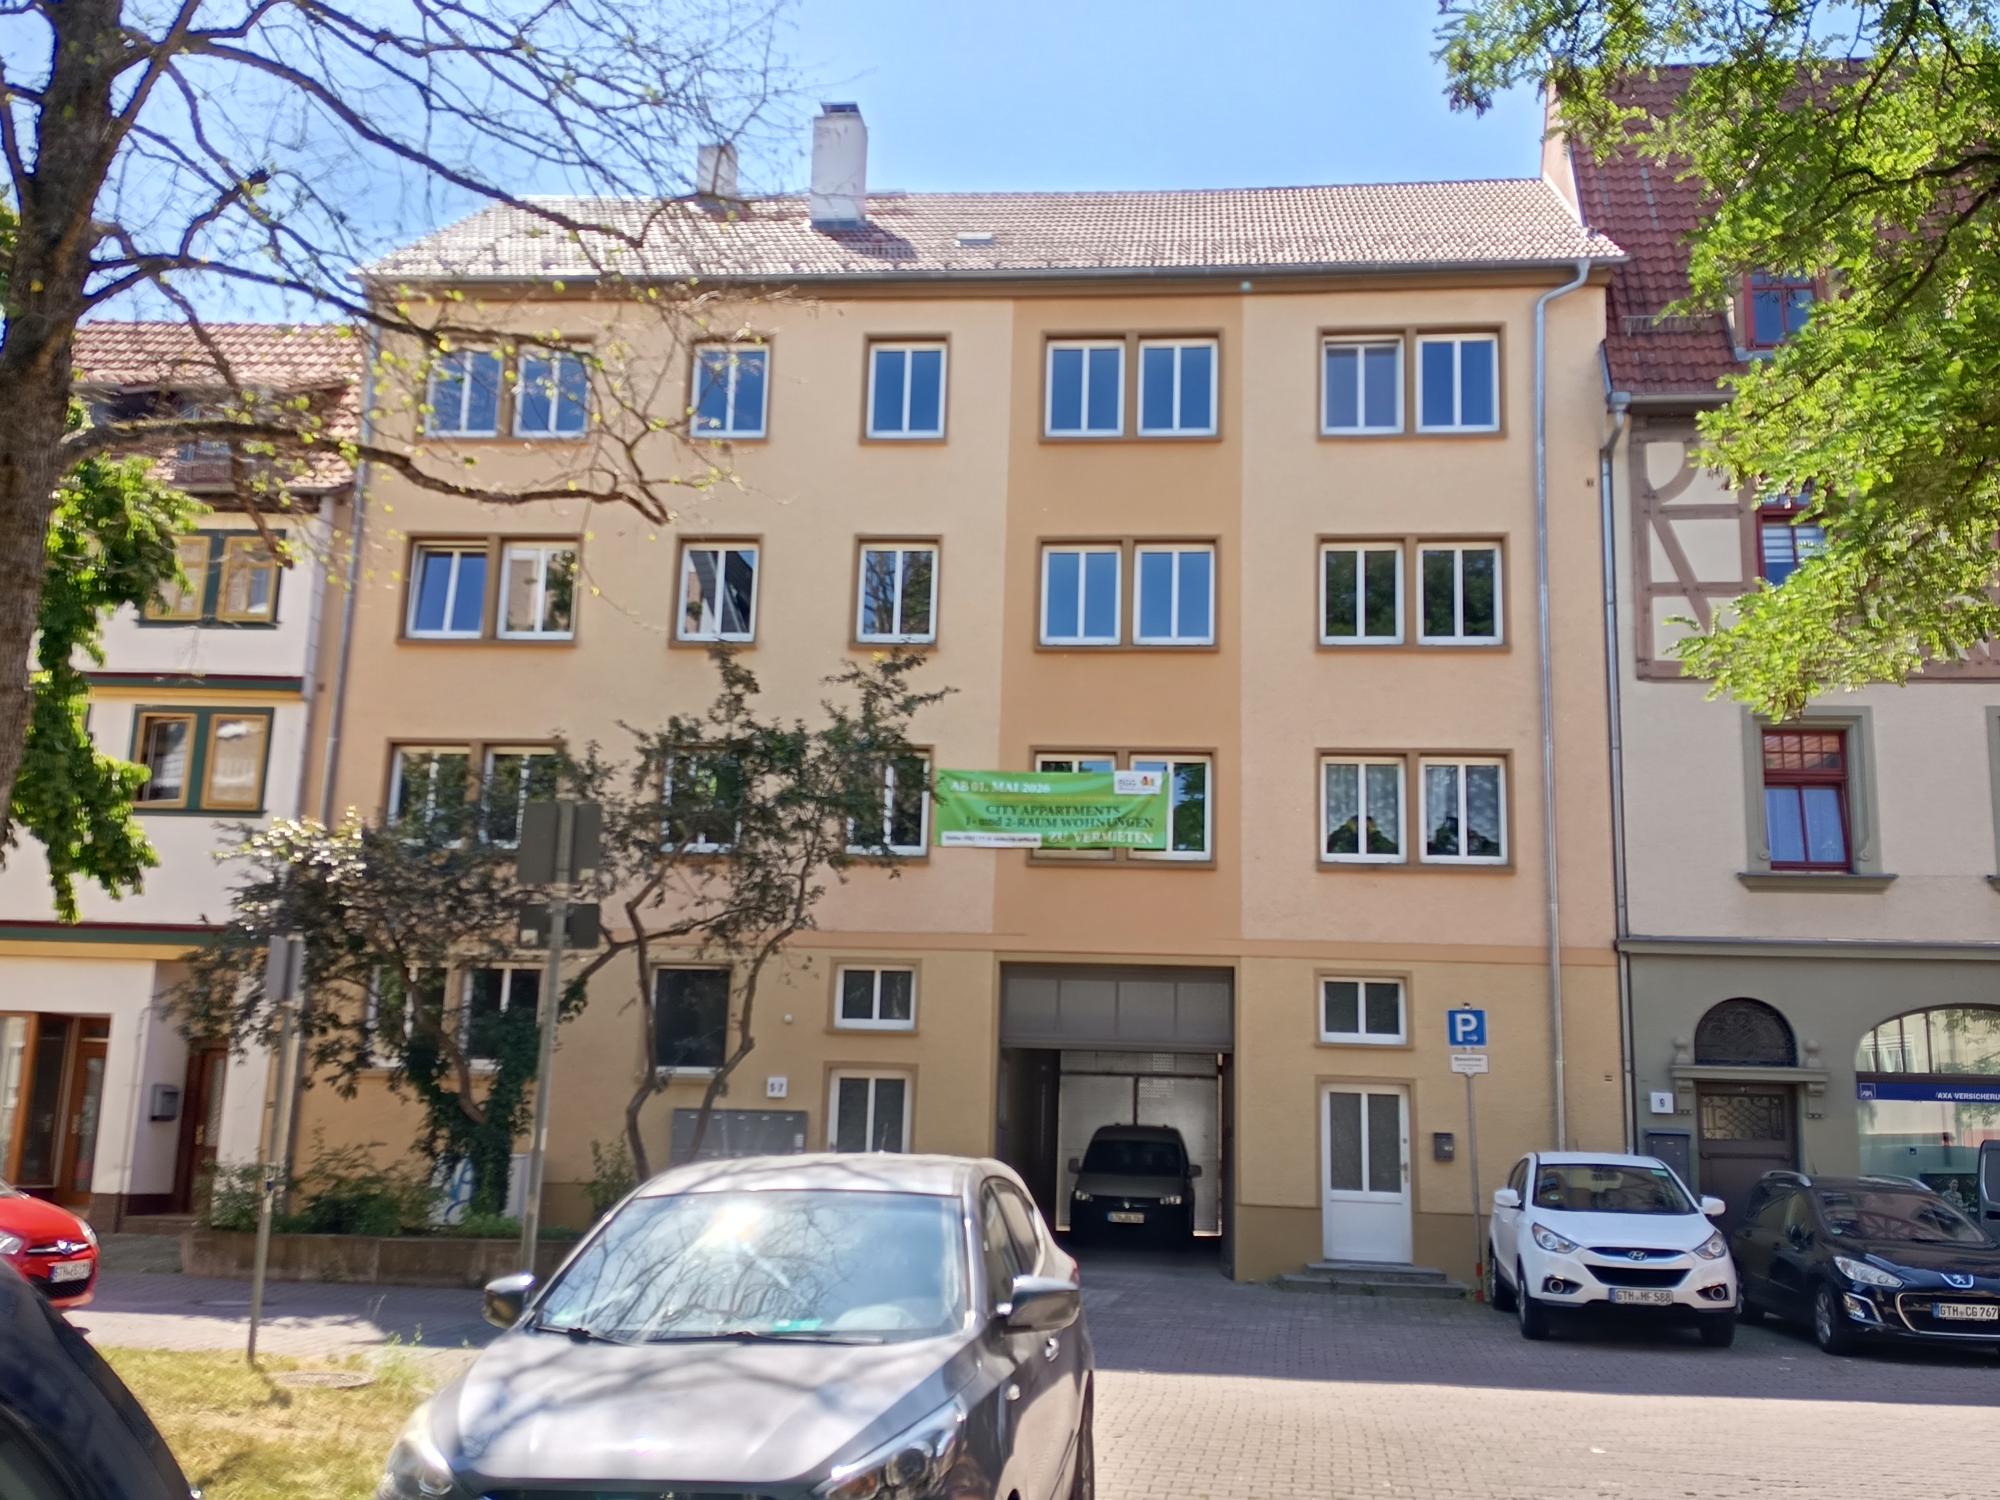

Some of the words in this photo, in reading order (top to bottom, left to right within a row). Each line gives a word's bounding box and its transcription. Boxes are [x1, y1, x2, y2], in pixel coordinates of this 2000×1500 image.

[950, 781, 969, 792] AB
[992, 781, 1020, 793] MAI
[985, 805, 1017, 815] CITY
[1022, 805, 1120, 815] APPARTMENTS
[1060, 816, 1154, 828] WOHNUNGEN
[1048, 831, 1066, 843] ZU
[1071, 830, 1153, 843] VERMIETEN
[1454, 1013, 1478, 1042] P
[1937, 1091, 1953, 1099] AXA
[1616, 1290, 1633, 1301] GTH
[1940, 1304, 1959, 1316] GTH
[1966, 1306, 1978, 1317] CG
[1979, 1307, 1998, 1318] 767
